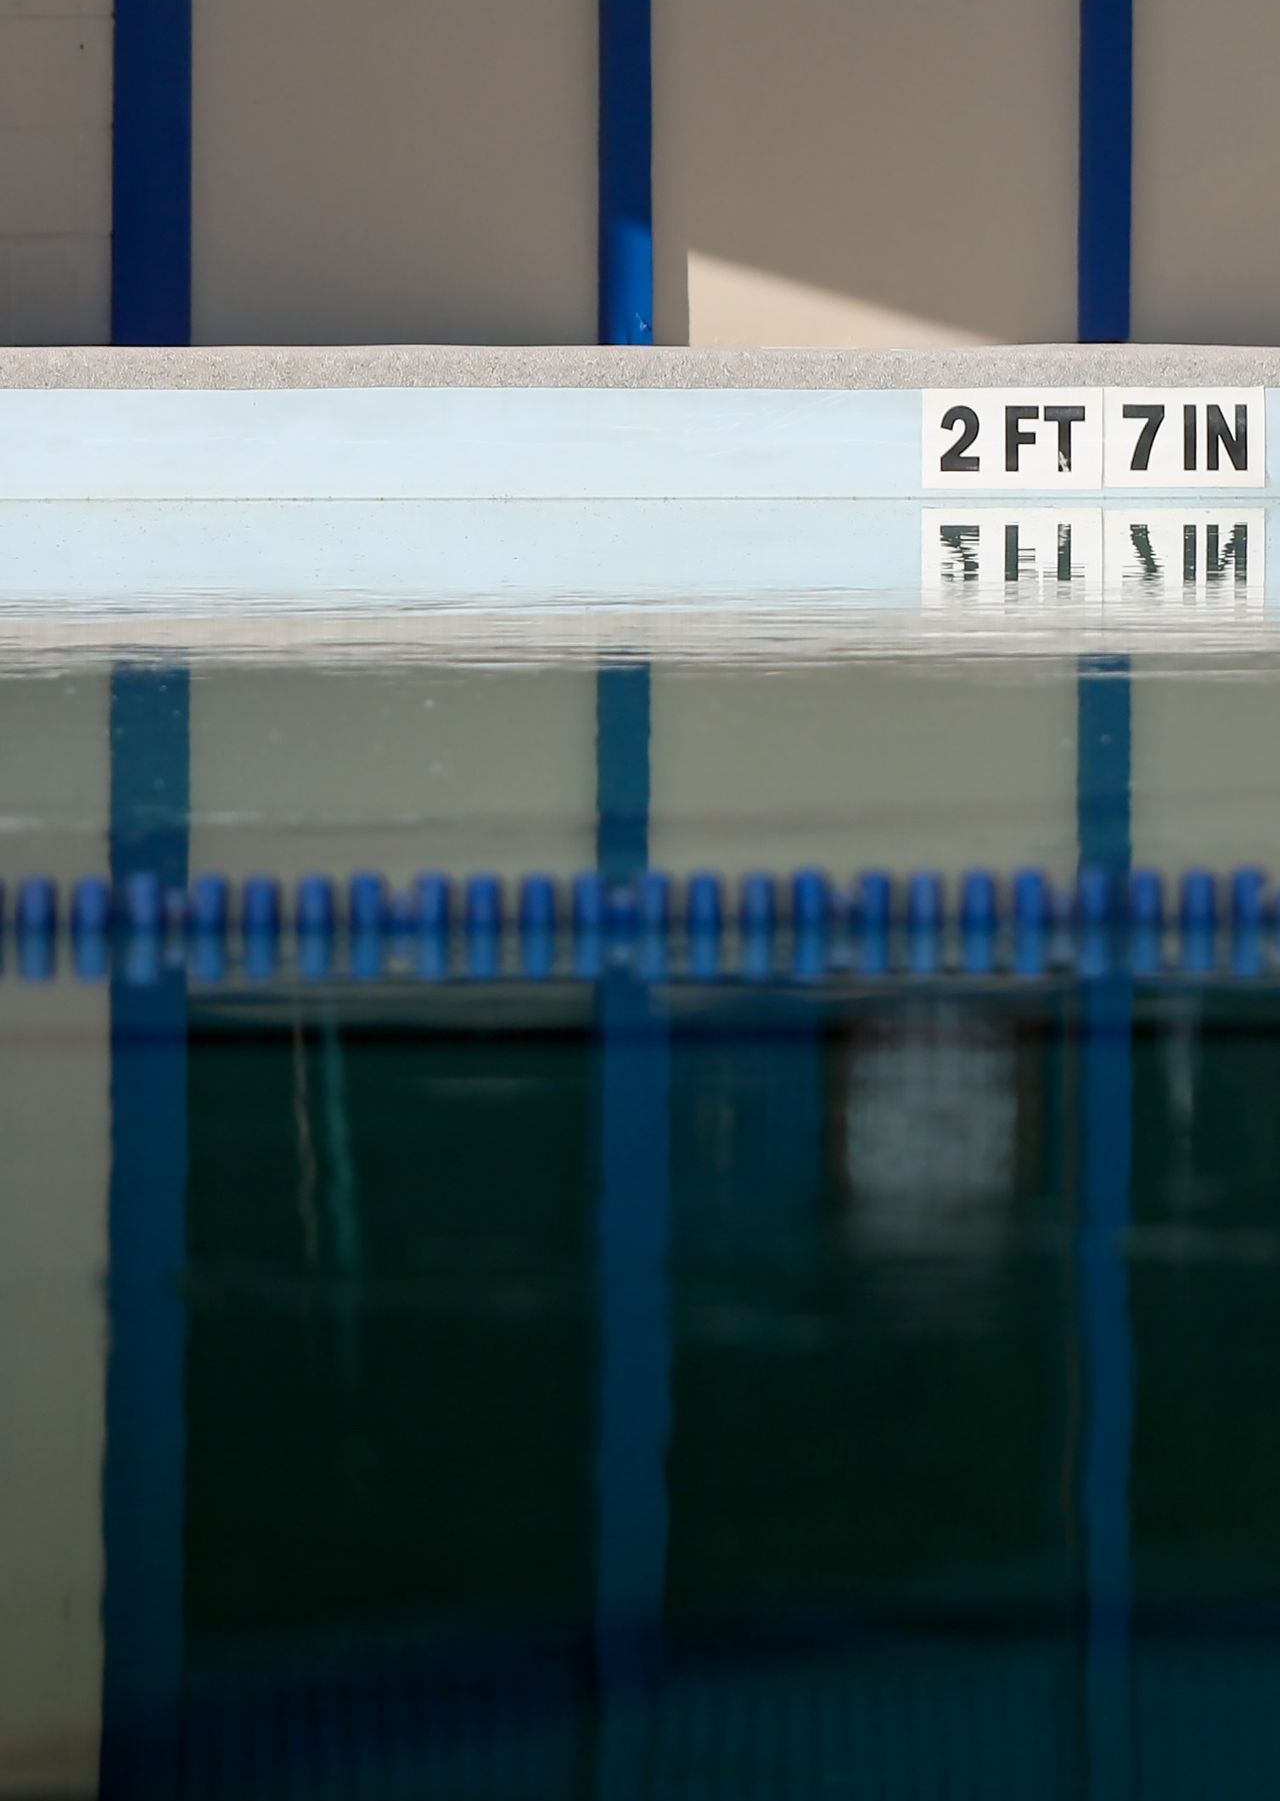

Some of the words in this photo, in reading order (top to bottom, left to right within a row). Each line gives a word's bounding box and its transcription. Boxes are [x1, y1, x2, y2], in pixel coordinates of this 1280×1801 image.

[940, 405, 980, 472] 2
[1005, 405, 1085, 472] FT
[1122, 404, 1165, 471] 7
[1183, 404, 1248, 471] IN
